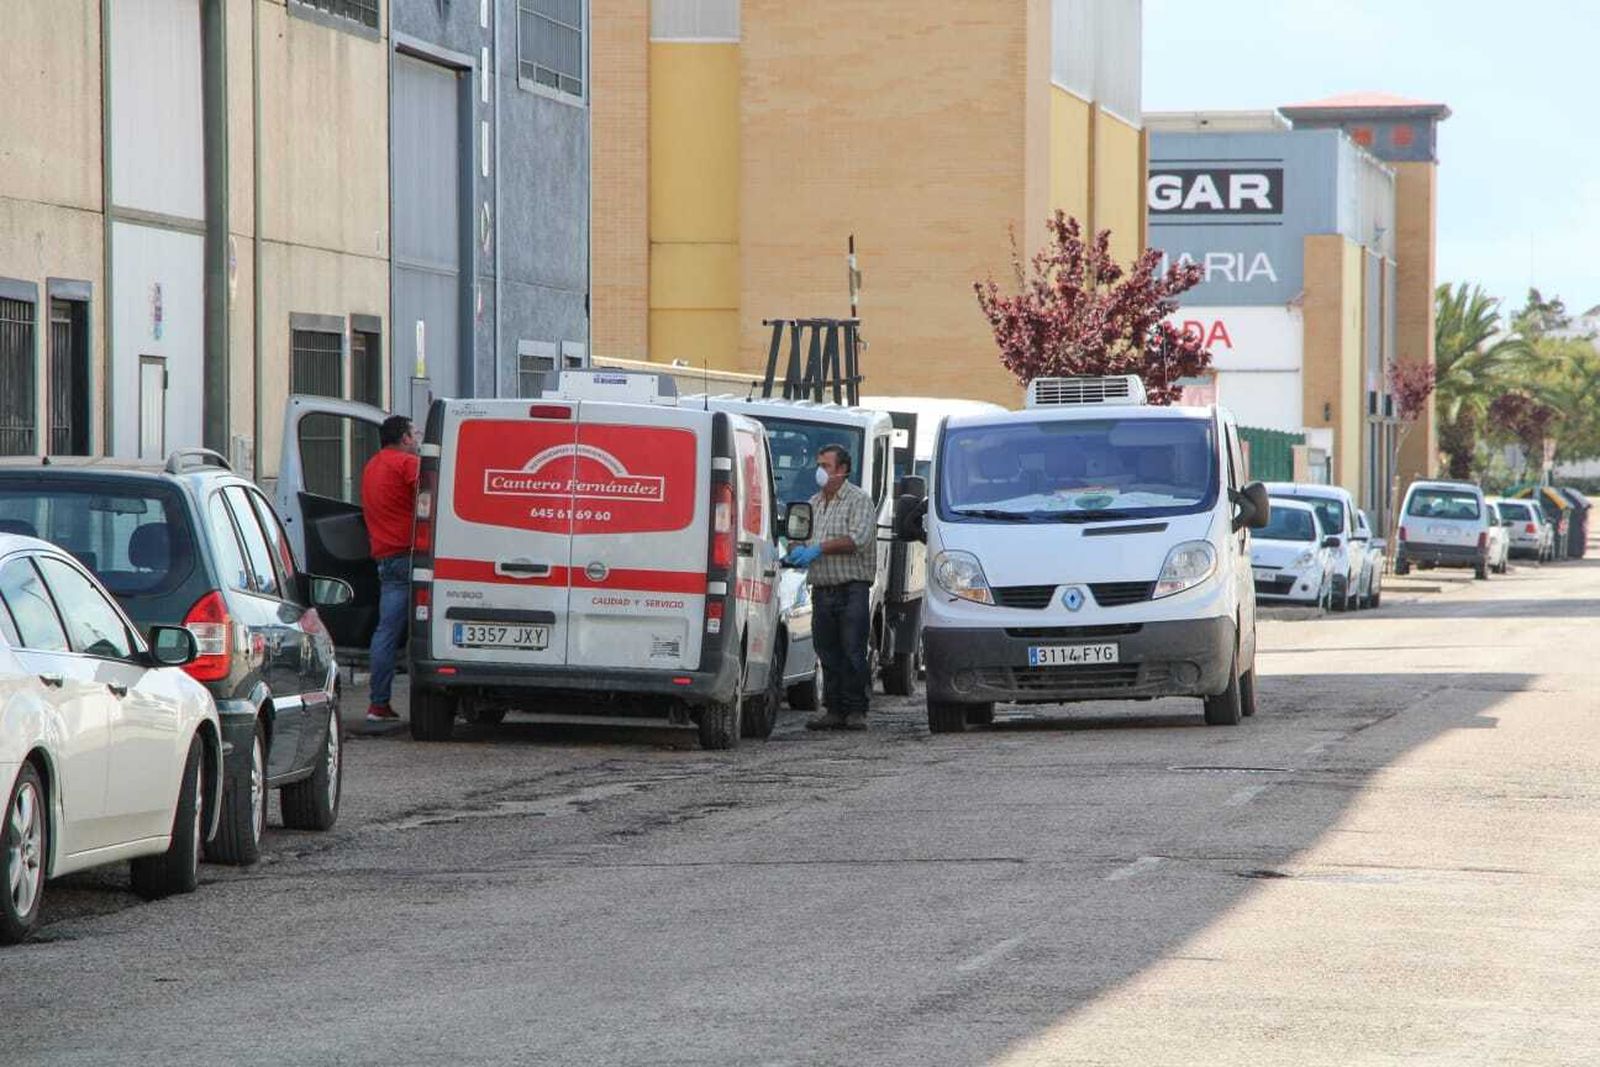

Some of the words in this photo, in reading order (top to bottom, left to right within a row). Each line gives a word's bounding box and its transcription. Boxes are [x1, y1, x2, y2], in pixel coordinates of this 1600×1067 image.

[1148, 174, 1273, 211] GAR
[491, 476, 561, 490] Cantero
[566, 479, 658, 495] Fernández
[530, 507, 554, 518] 645
[557, 509, 572, 519] 61
[575, 510, 592, 520] 69
[594, 511, 611, 521] 60
[592, 597, 630, 605] CALIDAD
[645, 600, 684, 608] SERVICIO
[467, 627, 508, 642] 3357
[513, 628, 543, 643] JXY
[1038, 649, 1077, 662] 3114
[1083, 646, 1113, 661] FYG
